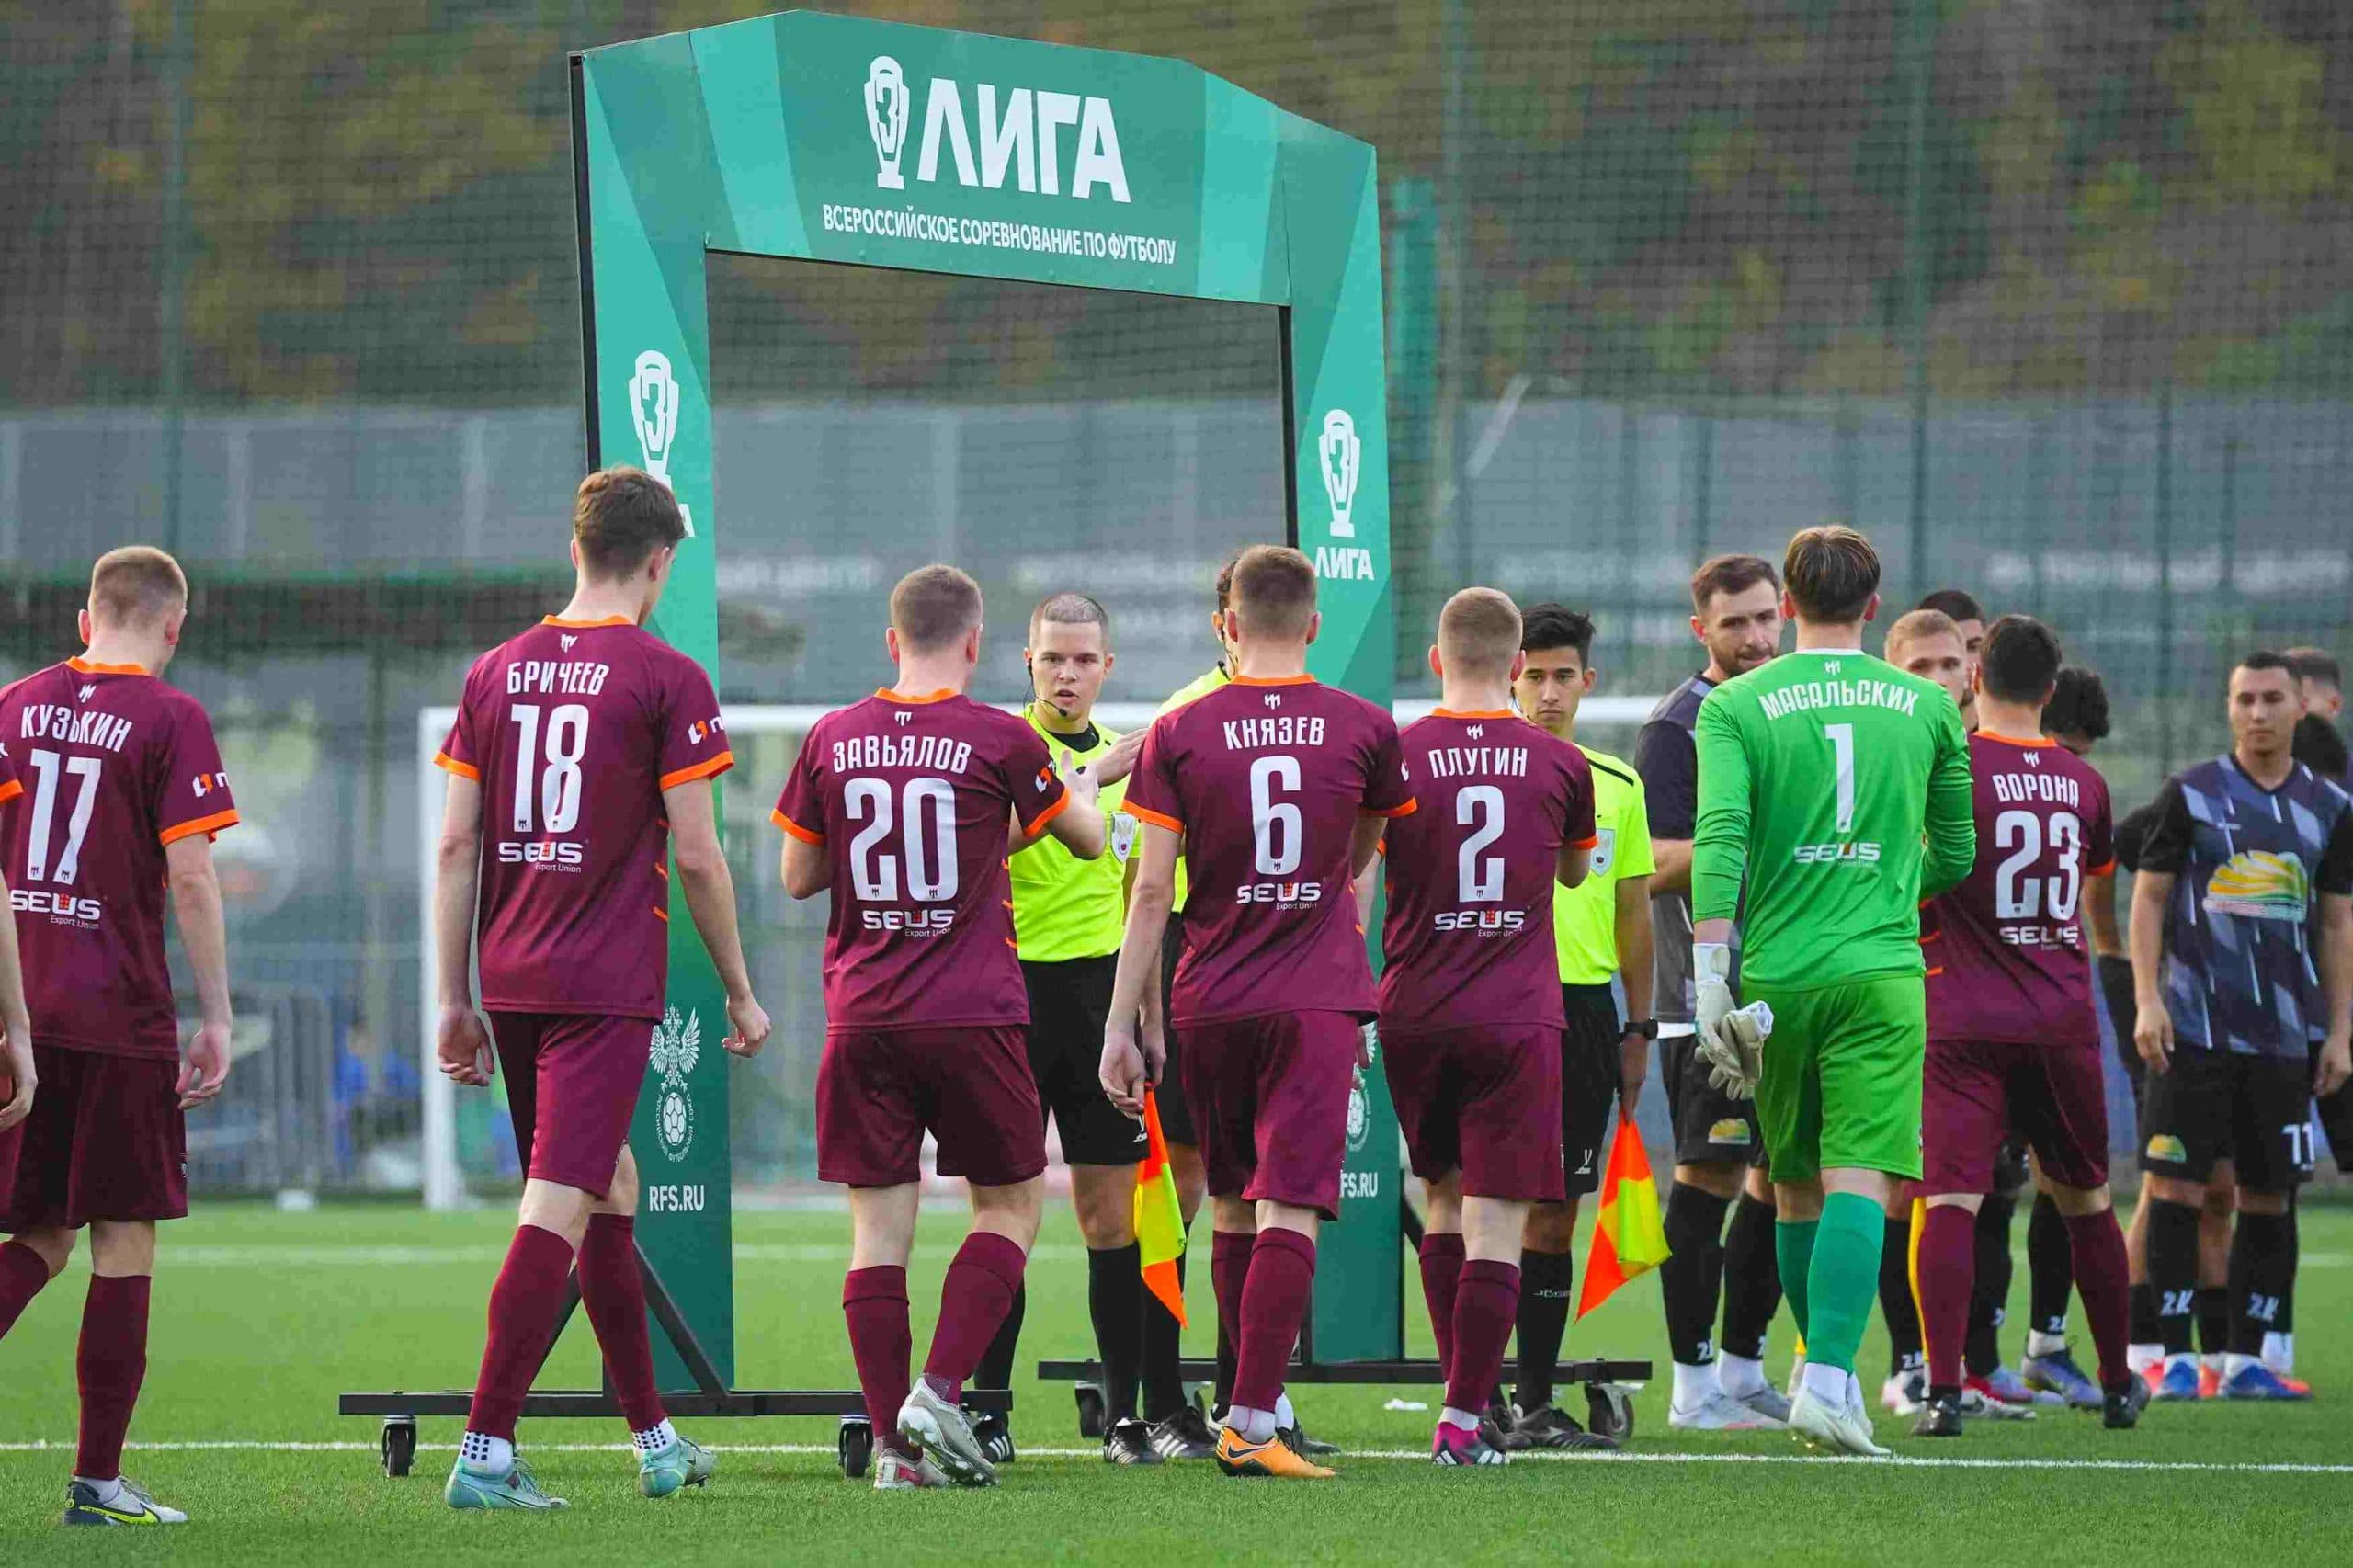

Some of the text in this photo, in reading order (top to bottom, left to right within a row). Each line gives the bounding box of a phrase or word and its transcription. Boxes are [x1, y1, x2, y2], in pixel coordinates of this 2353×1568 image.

[917, 77, 1131, 203] ЛИГА
[823, 204, 1176, 265] ВСЕРОССИЙСКОЕ СОРЕВНОВАНИЕ ПО ФУТБОЛУ
[1314, 547, 1375, 581] ЛИГА
[506, 661, 610, 696] БРИЧЕЕВ
[1758, 679, 1919, 721] МАСАЛЬСКИХ
[20, 704, 133, 752] КУЗЬКИН
[1222, 716, 1325, 750] КНЯЗЕВ
[511, 703, 589, 833] 18
[833, 734, 972, 775] ЗАВЬЯЛОВ
[1428, 747, 1528, 778] ПЛУГИН
[1824, 723, 1854, 833] 1
[1992, 774, 2080, 808] ВОРОНА
[27, 748, 102, 885] 17
[1250, 755, 1302, 875] 6
[499, 842, 584, 863] SEUS
[844, 778, 959, 901] 20
[1456, 784, 1505, 903] 2
[1793, 841, 1881, 863] SEUS
[557, 863, 581, 873] Union
[1995, 810, 2081, 920] 23
[10, 890, 101, 921] SEUS
[1236, 882, 1322, 904] SEUS
[862, 908, 956, 930] SEUS
[1435, 910, 1525, 931] SEUS
[649, 1185, 705, 1212] RFS.RU
[1339, 1172, 1379, 1199] FS.RU
